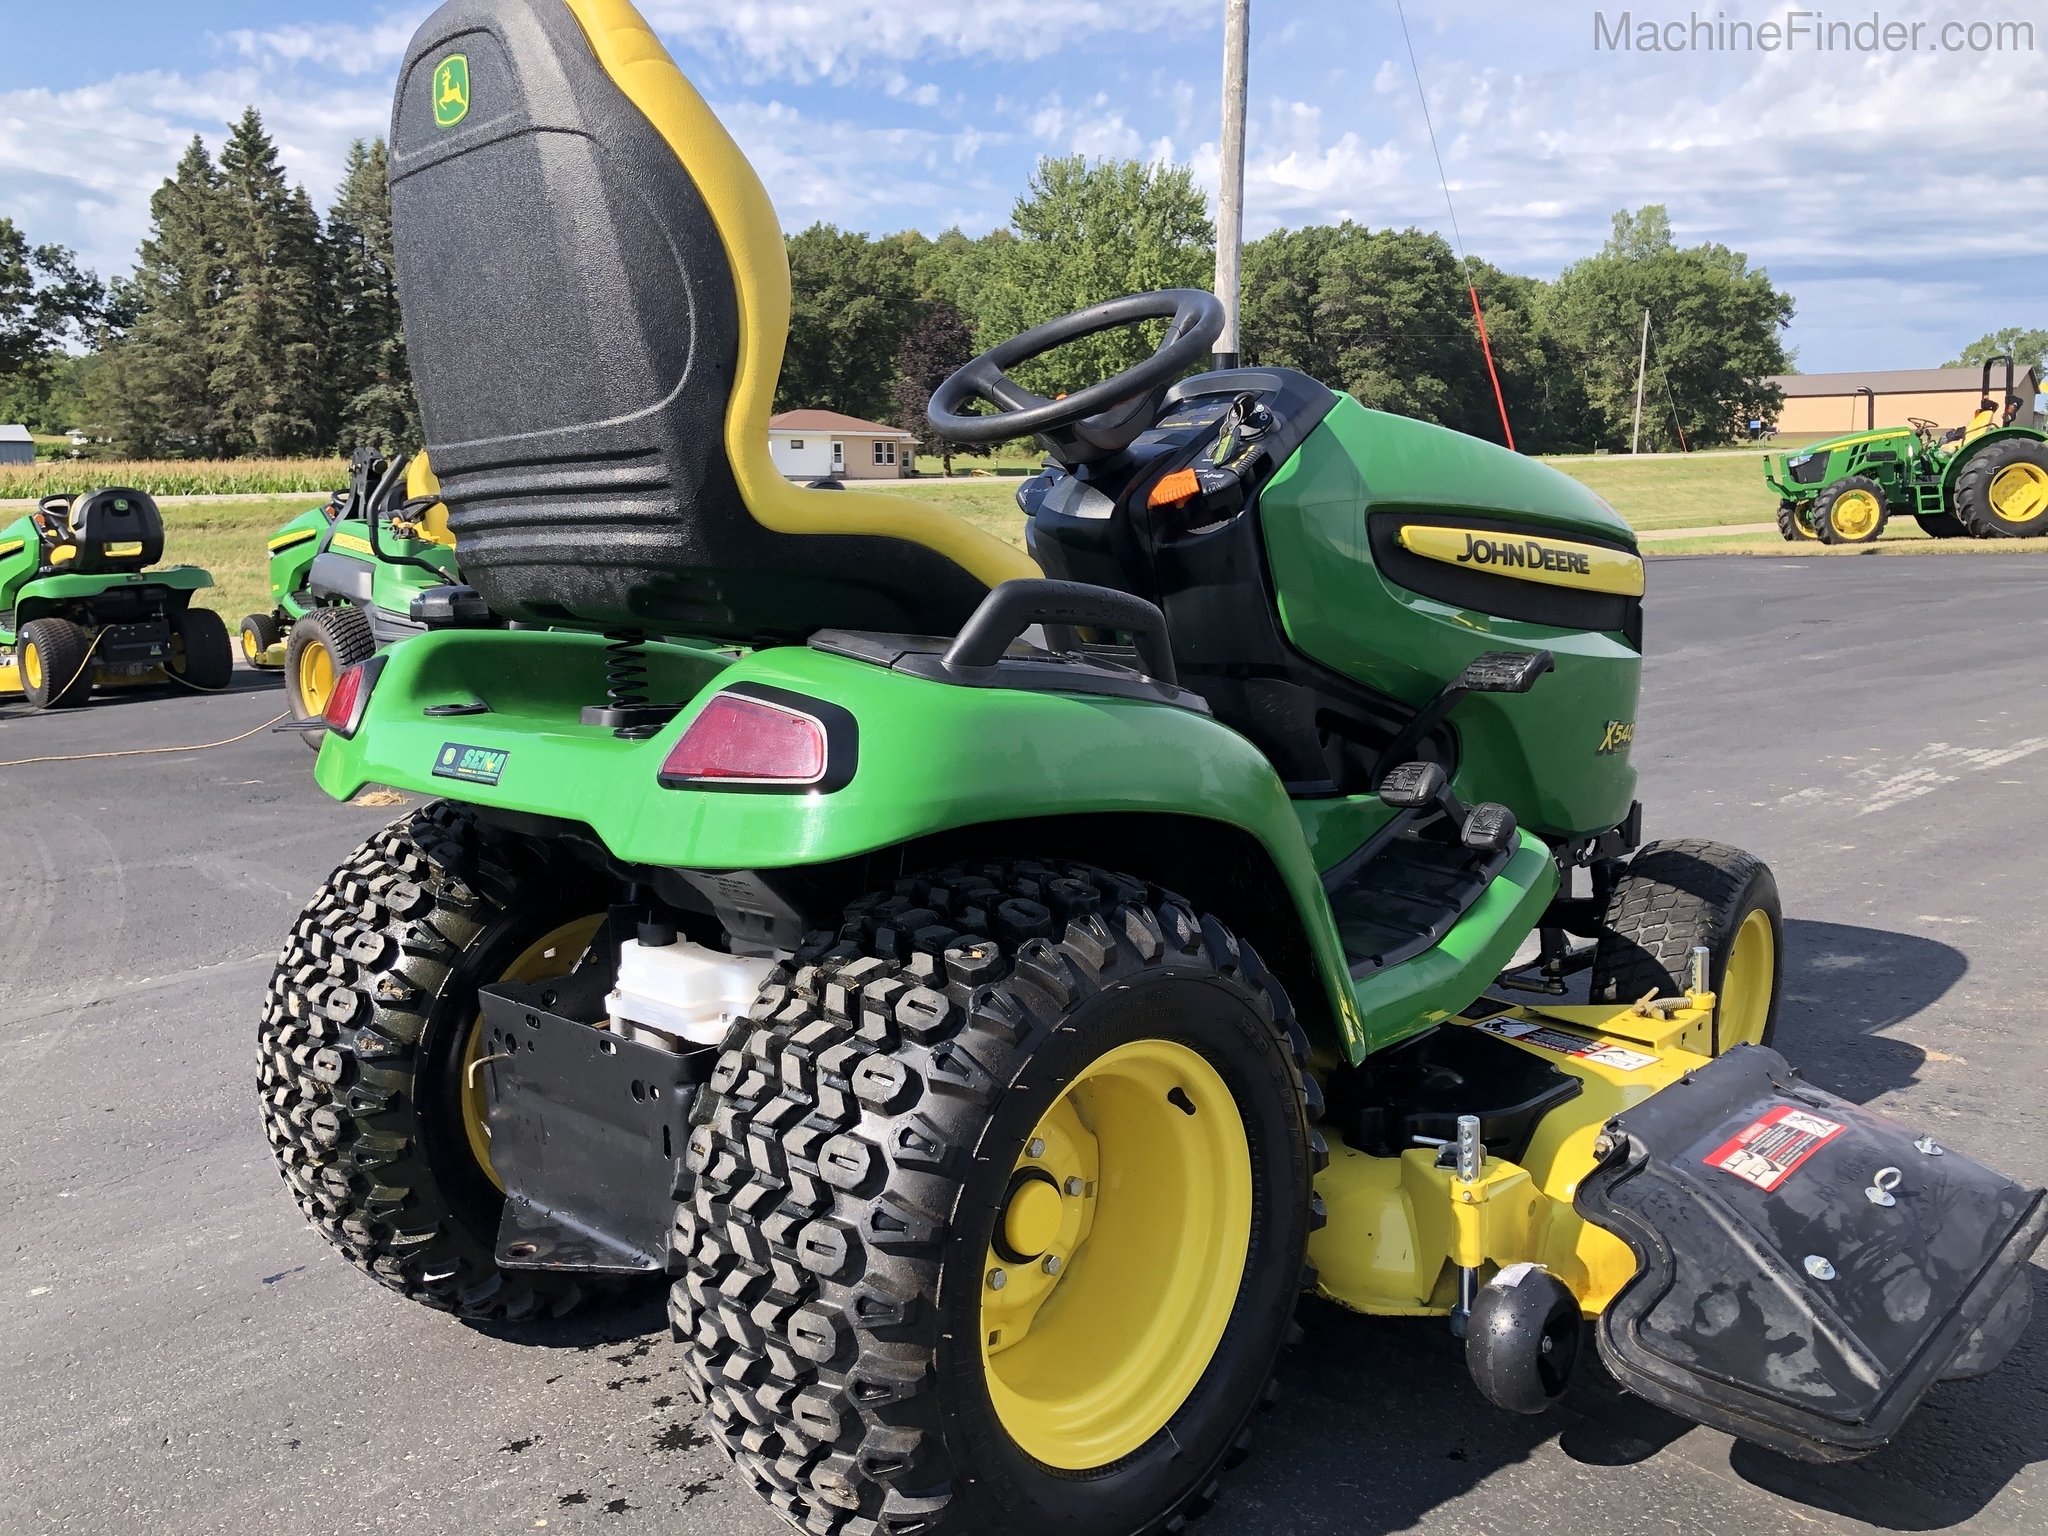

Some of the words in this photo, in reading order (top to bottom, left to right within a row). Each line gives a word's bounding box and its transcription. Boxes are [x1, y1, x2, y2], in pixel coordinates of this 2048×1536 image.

[1456, 533, 1525, 567] JOHN
[1524, 541, 1590, 575] DEERE
[1598, 720, 1636, 751] X540
[460, 748, 507, 773] SEMA
